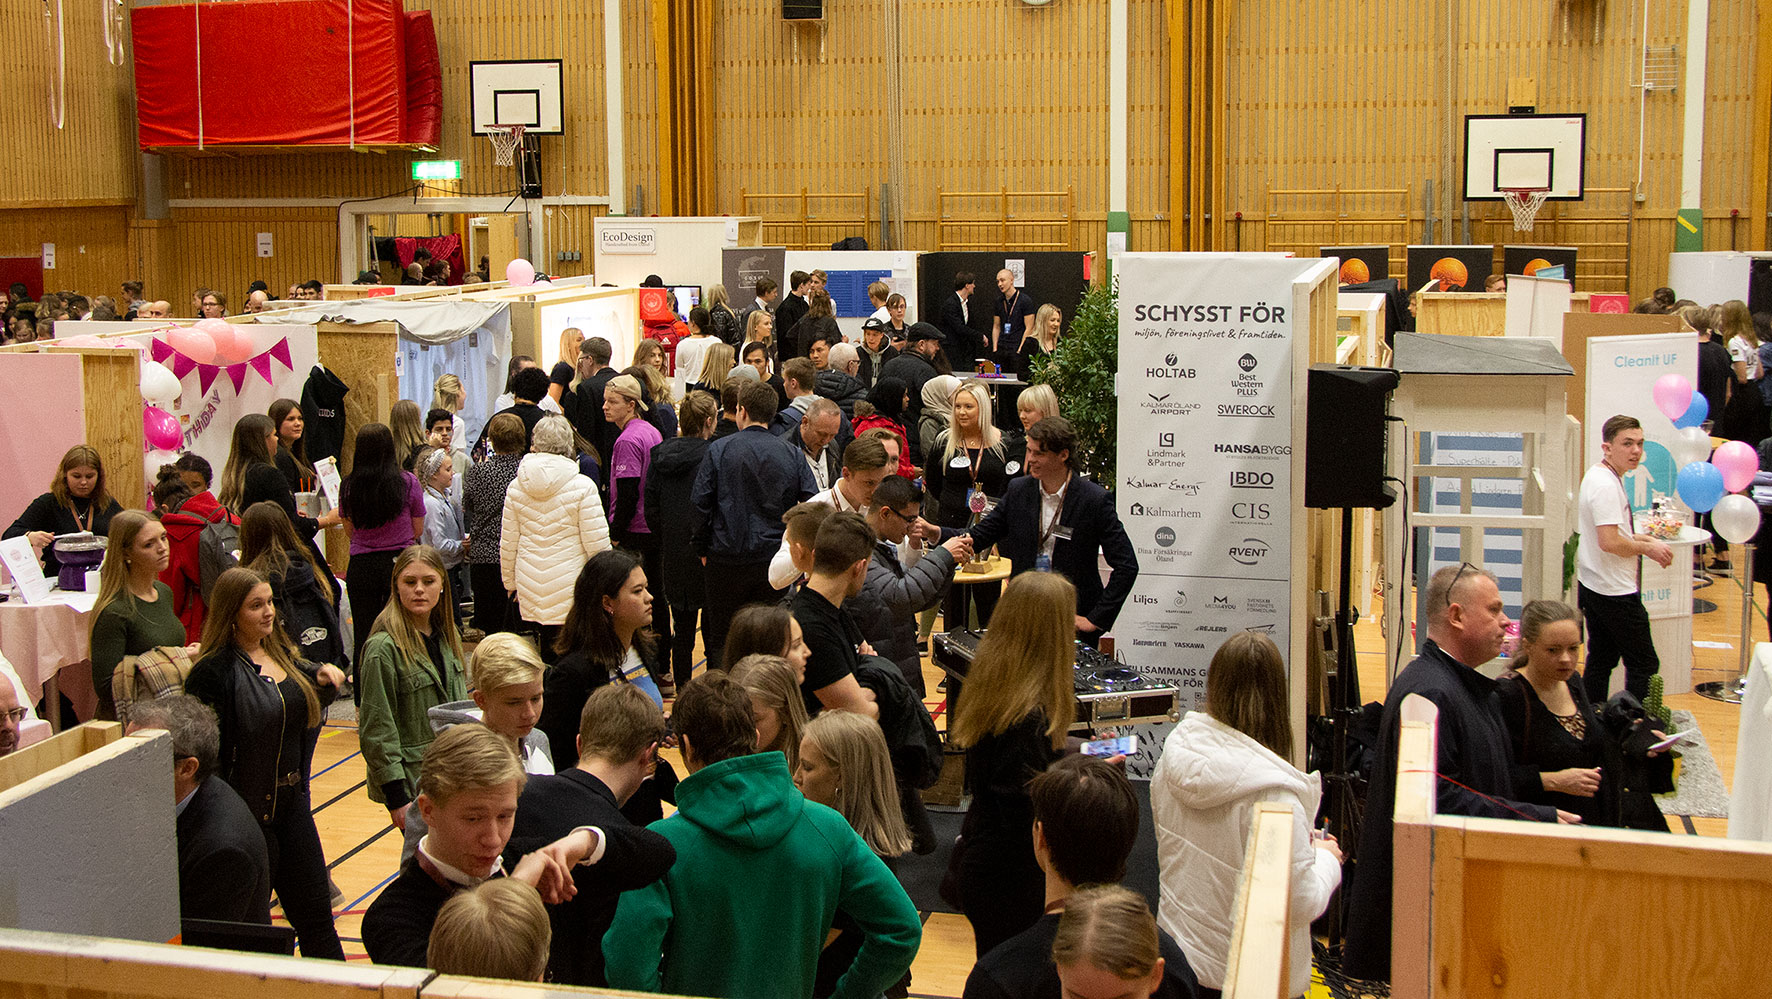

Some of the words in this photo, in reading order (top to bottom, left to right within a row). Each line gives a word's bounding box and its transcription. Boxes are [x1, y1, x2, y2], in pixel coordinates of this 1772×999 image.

[602, 231, 653, 244] EcoDesign
[1135, 304, 1232, 322] SCHYSST
[1239, 302, 1286, 323] FÖR
[1134, 328, 1162, 339] miljön,
[1165, 328, 1225, 340] föreningslivet
[1227, 329, 1236, 339] &
[1238, 329, 1286, 340] framtiden.
[1663, 353, 1677, 365] UF
[1146, 367, 1197, 379] HOLTAB
[1239, 373, 1257, 381] Best
[1231, 380, 1264, 388] Western
[1237, 388, 1258, 396] PLUS
[1217, 404, 1275, 416] SWEROCK
[177, 389, 221, 454] THDAY
[1147, 449, 1186, 458] Lindmark
[1214, 444, 1292, 455] HANSABYGG
[1147, 458, 1186, 467] &Partner
[1126, 476, 1167, 489] Kalmar
[1168, 479, 1206, 496] Energi
[1146, 506, 1201, 518] Kalmarhem
[1231, 502, 1271, 520] CIS
[1155, 532, 1175, 540] dina
[1137, 547, 1153, 555] Dina
[1153, 548, 1193, 557] Försäkringar
[1229, 547, 1268, 557] AVENT
[1133, 594, 1159, 606] Liljas
[1657, 588, 1671, 601] UF
[1199, 625, 1227, 633] REJLERS
[1173, 641, 1205, 649] YASKAWA
[1183, 678, 1204, 688] FÖR
